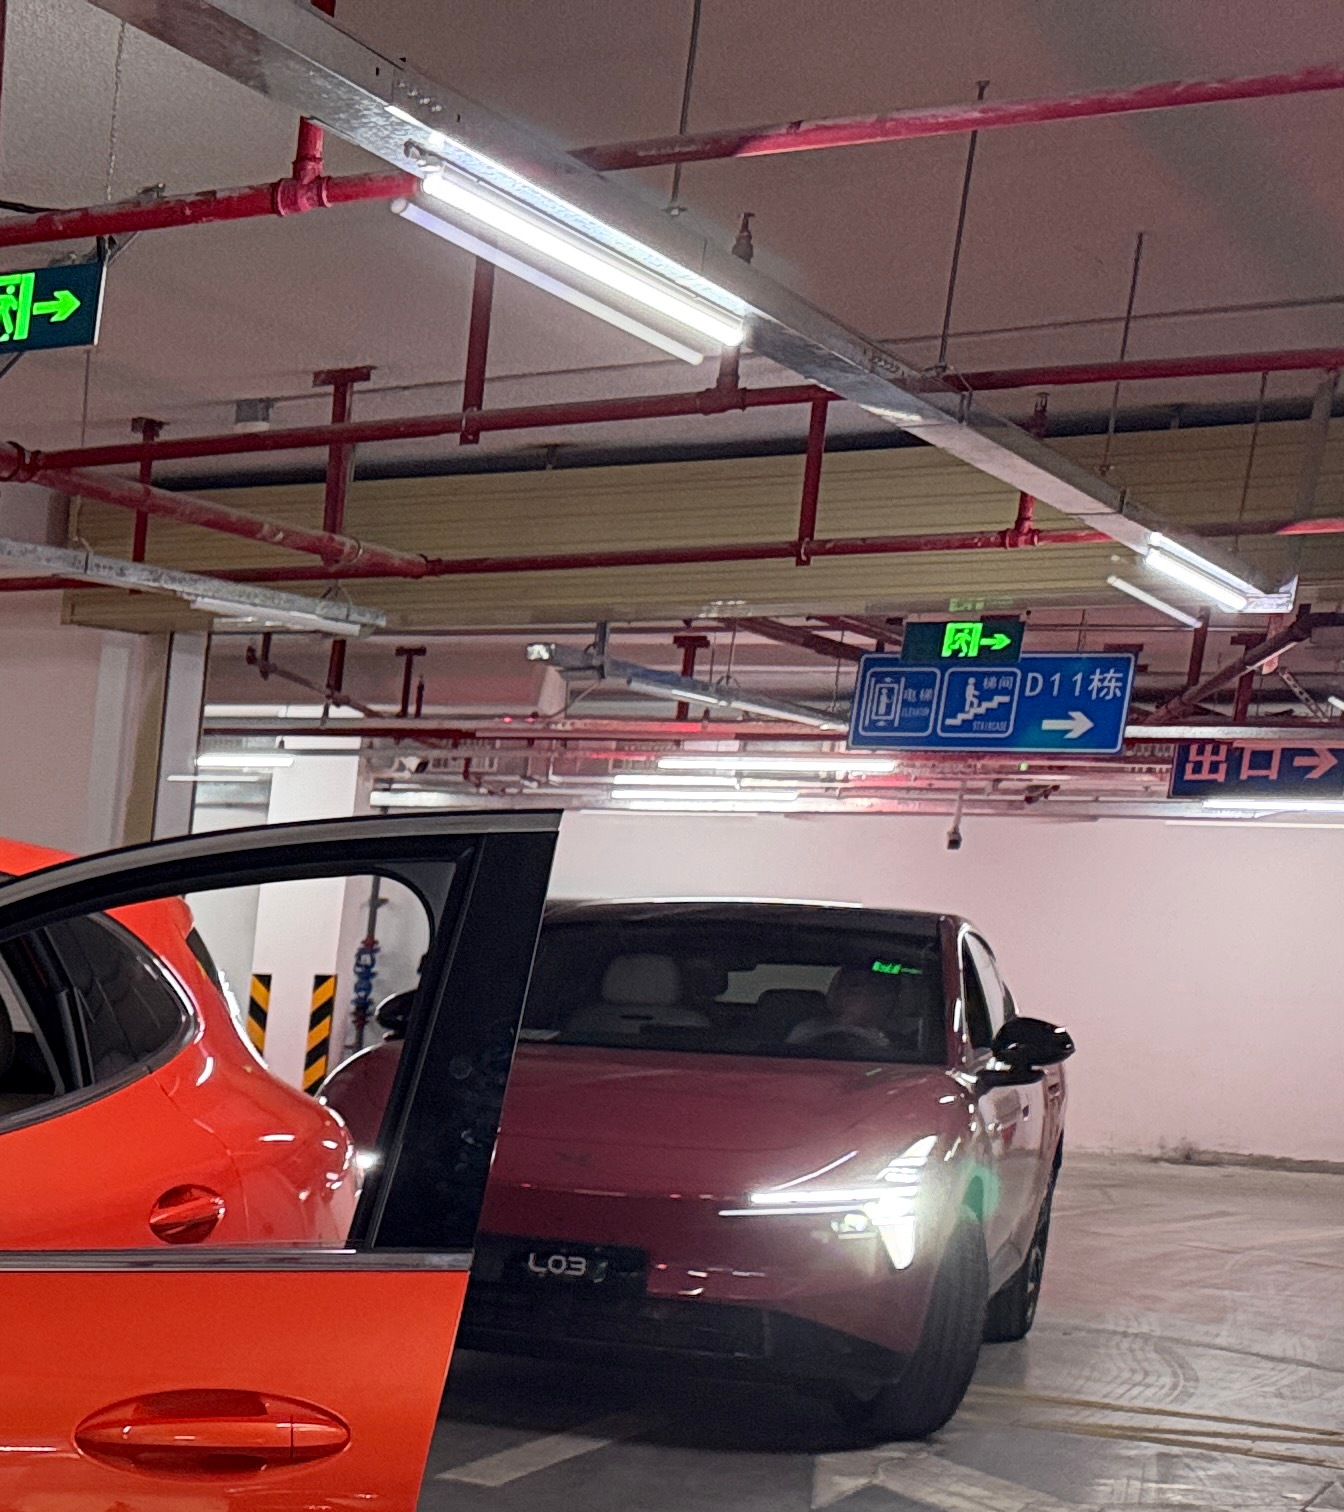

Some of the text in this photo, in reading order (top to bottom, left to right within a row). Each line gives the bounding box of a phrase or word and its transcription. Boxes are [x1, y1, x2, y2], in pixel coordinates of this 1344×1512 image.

[983, 675, 1014, 690] 梯间
[1024, 668, 1123, 701] D11栋
[1184, 743, 1282, 782] 出口
